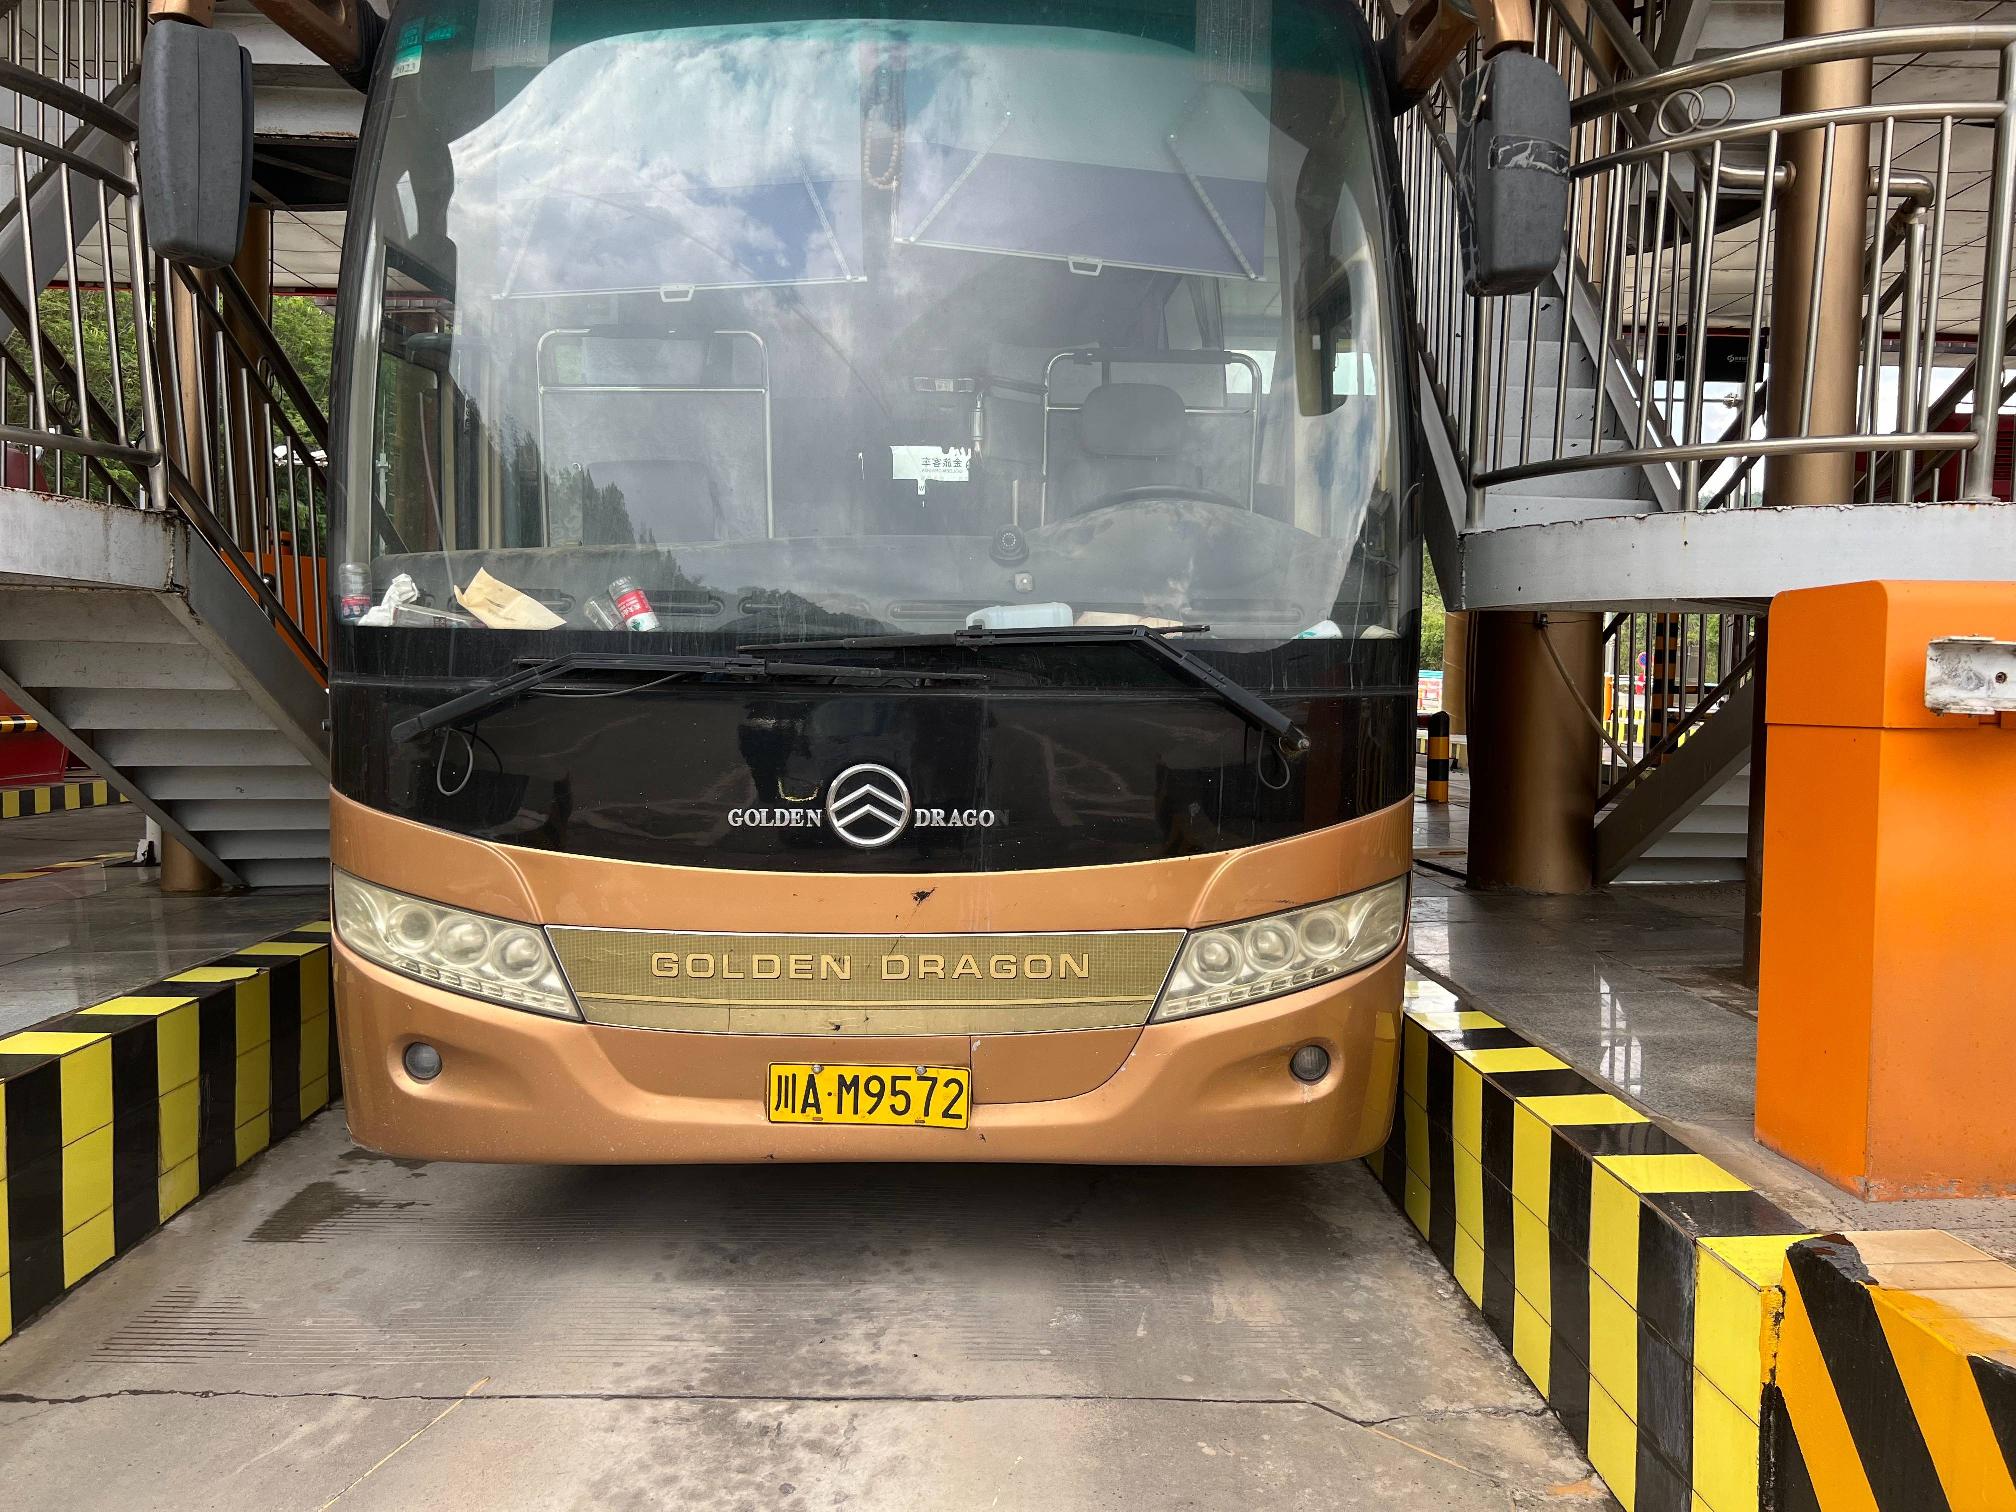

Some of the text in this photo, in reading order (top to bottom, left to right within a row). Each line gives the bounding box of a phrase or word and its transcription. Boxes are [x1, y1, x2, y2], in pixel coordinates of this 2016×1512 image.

[727, 808, 822, 828] GOLDEN
[650, 952, 1090, 980] GOLDEN DRAGON
[774, 1073, 965, 1120] 川A·M9572
